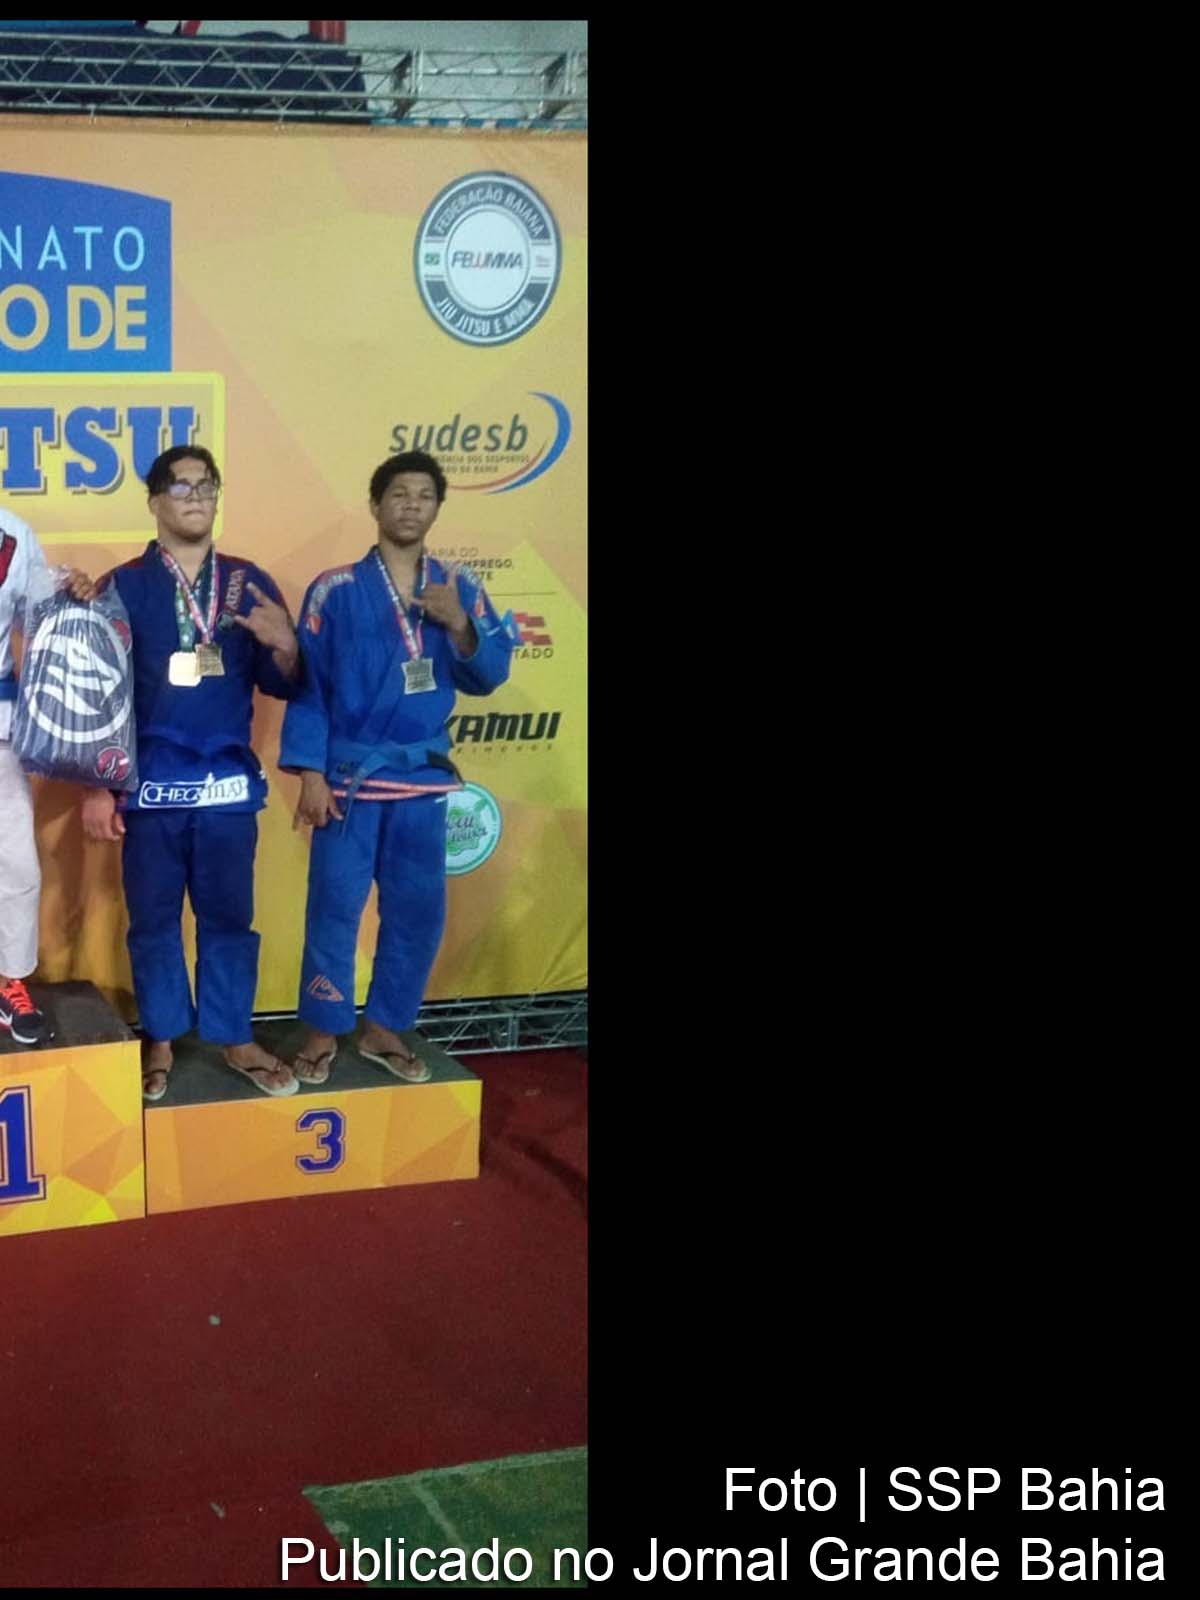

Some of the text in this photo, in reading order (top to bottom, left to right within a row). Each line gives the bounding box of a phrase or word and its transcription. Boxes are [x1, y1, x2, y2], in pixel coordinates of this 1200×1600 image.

[503, 191, 545, 237] BAIANA
[67, 284, 147, 351] DE
[436, 298, 458, 317] JIU
[455, 313, 491, 336] JITSU
[388, 413, 528, 453] sudesb
[296, 1107, 347, 1174] 3
